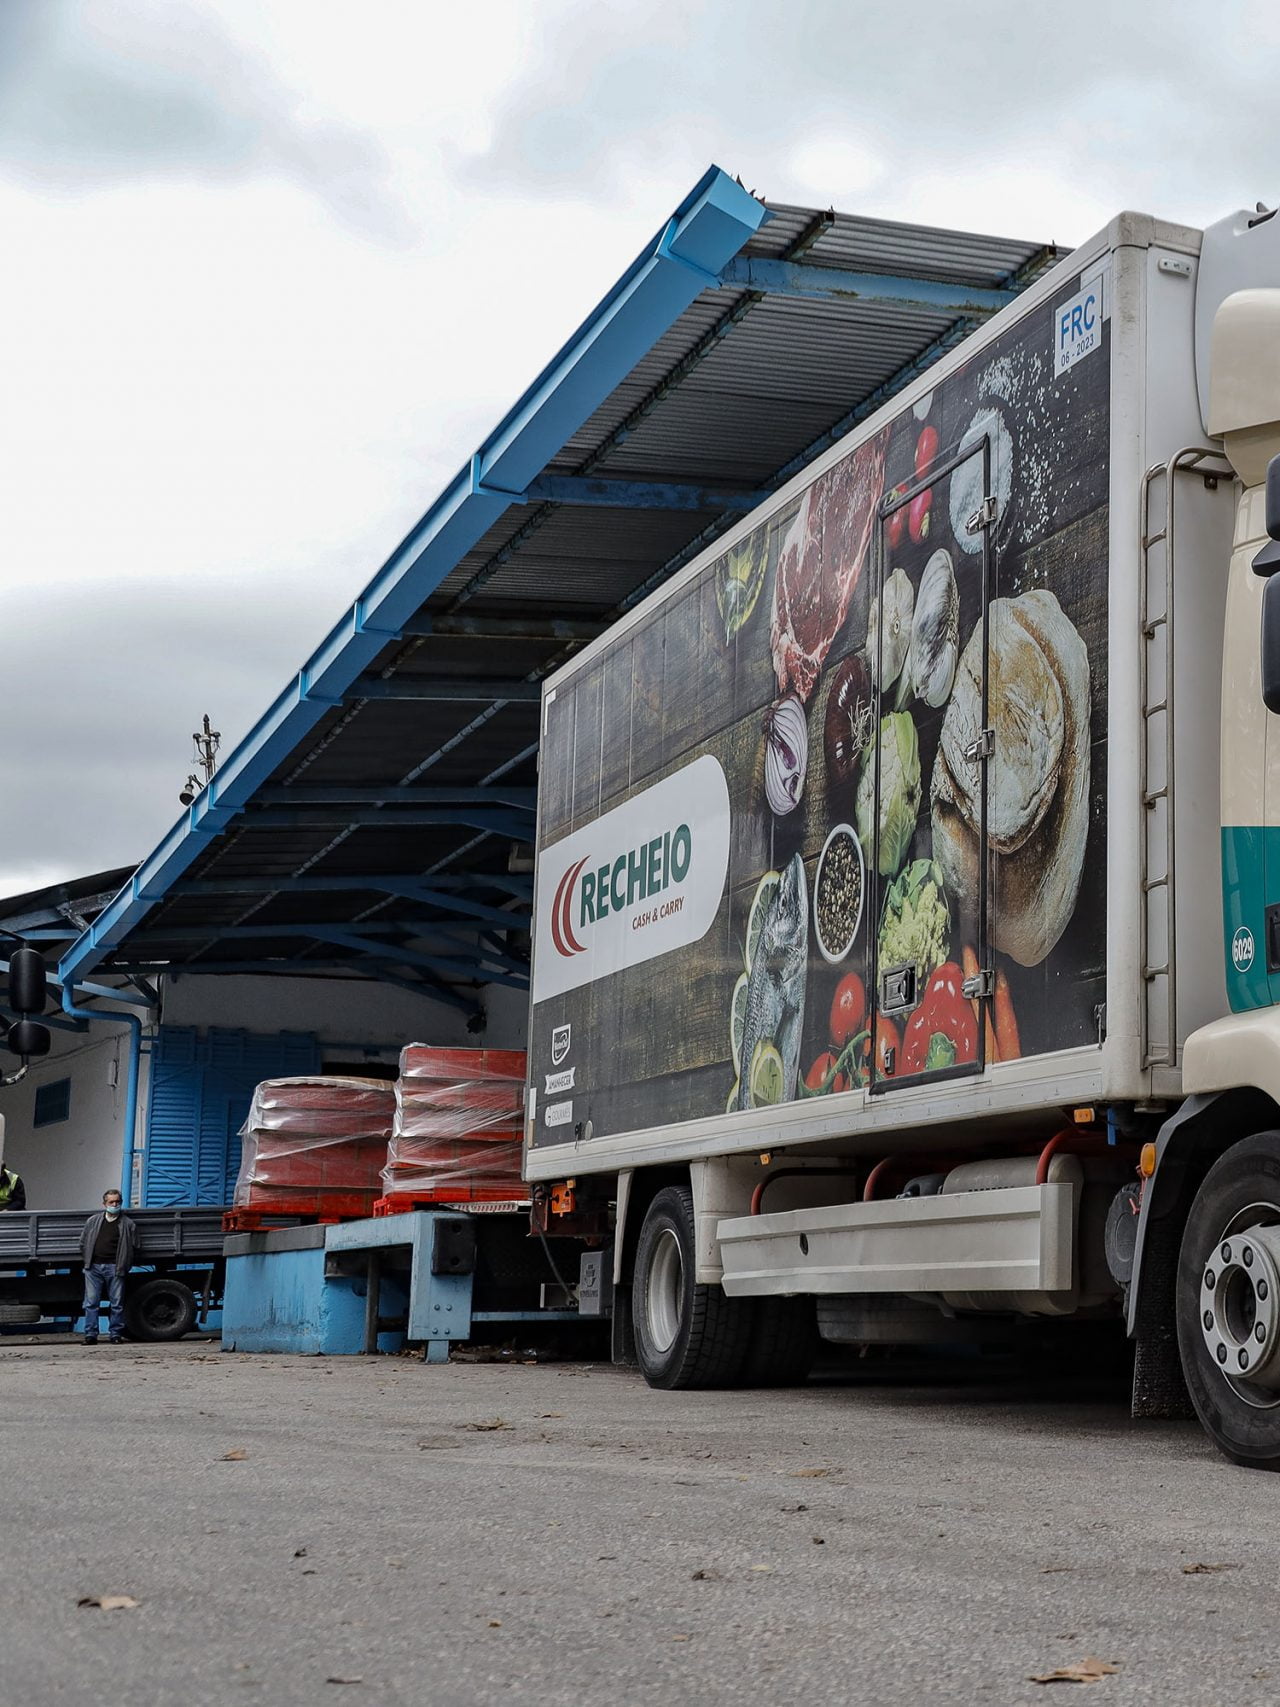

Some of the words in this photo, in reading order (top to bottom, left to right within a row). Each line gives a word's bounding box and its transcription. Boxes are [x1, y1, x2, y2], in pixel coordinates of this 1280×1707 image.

[1061, 294, 1095, 350] FRC
[580, 823, 692, 928] RECHEIO
[632, 911, 651, 930] CASH
[652, 908, 658, 922] &
[660, 896, 684, 918] CARRY
[1233, 936, 1253, 962] 6029
